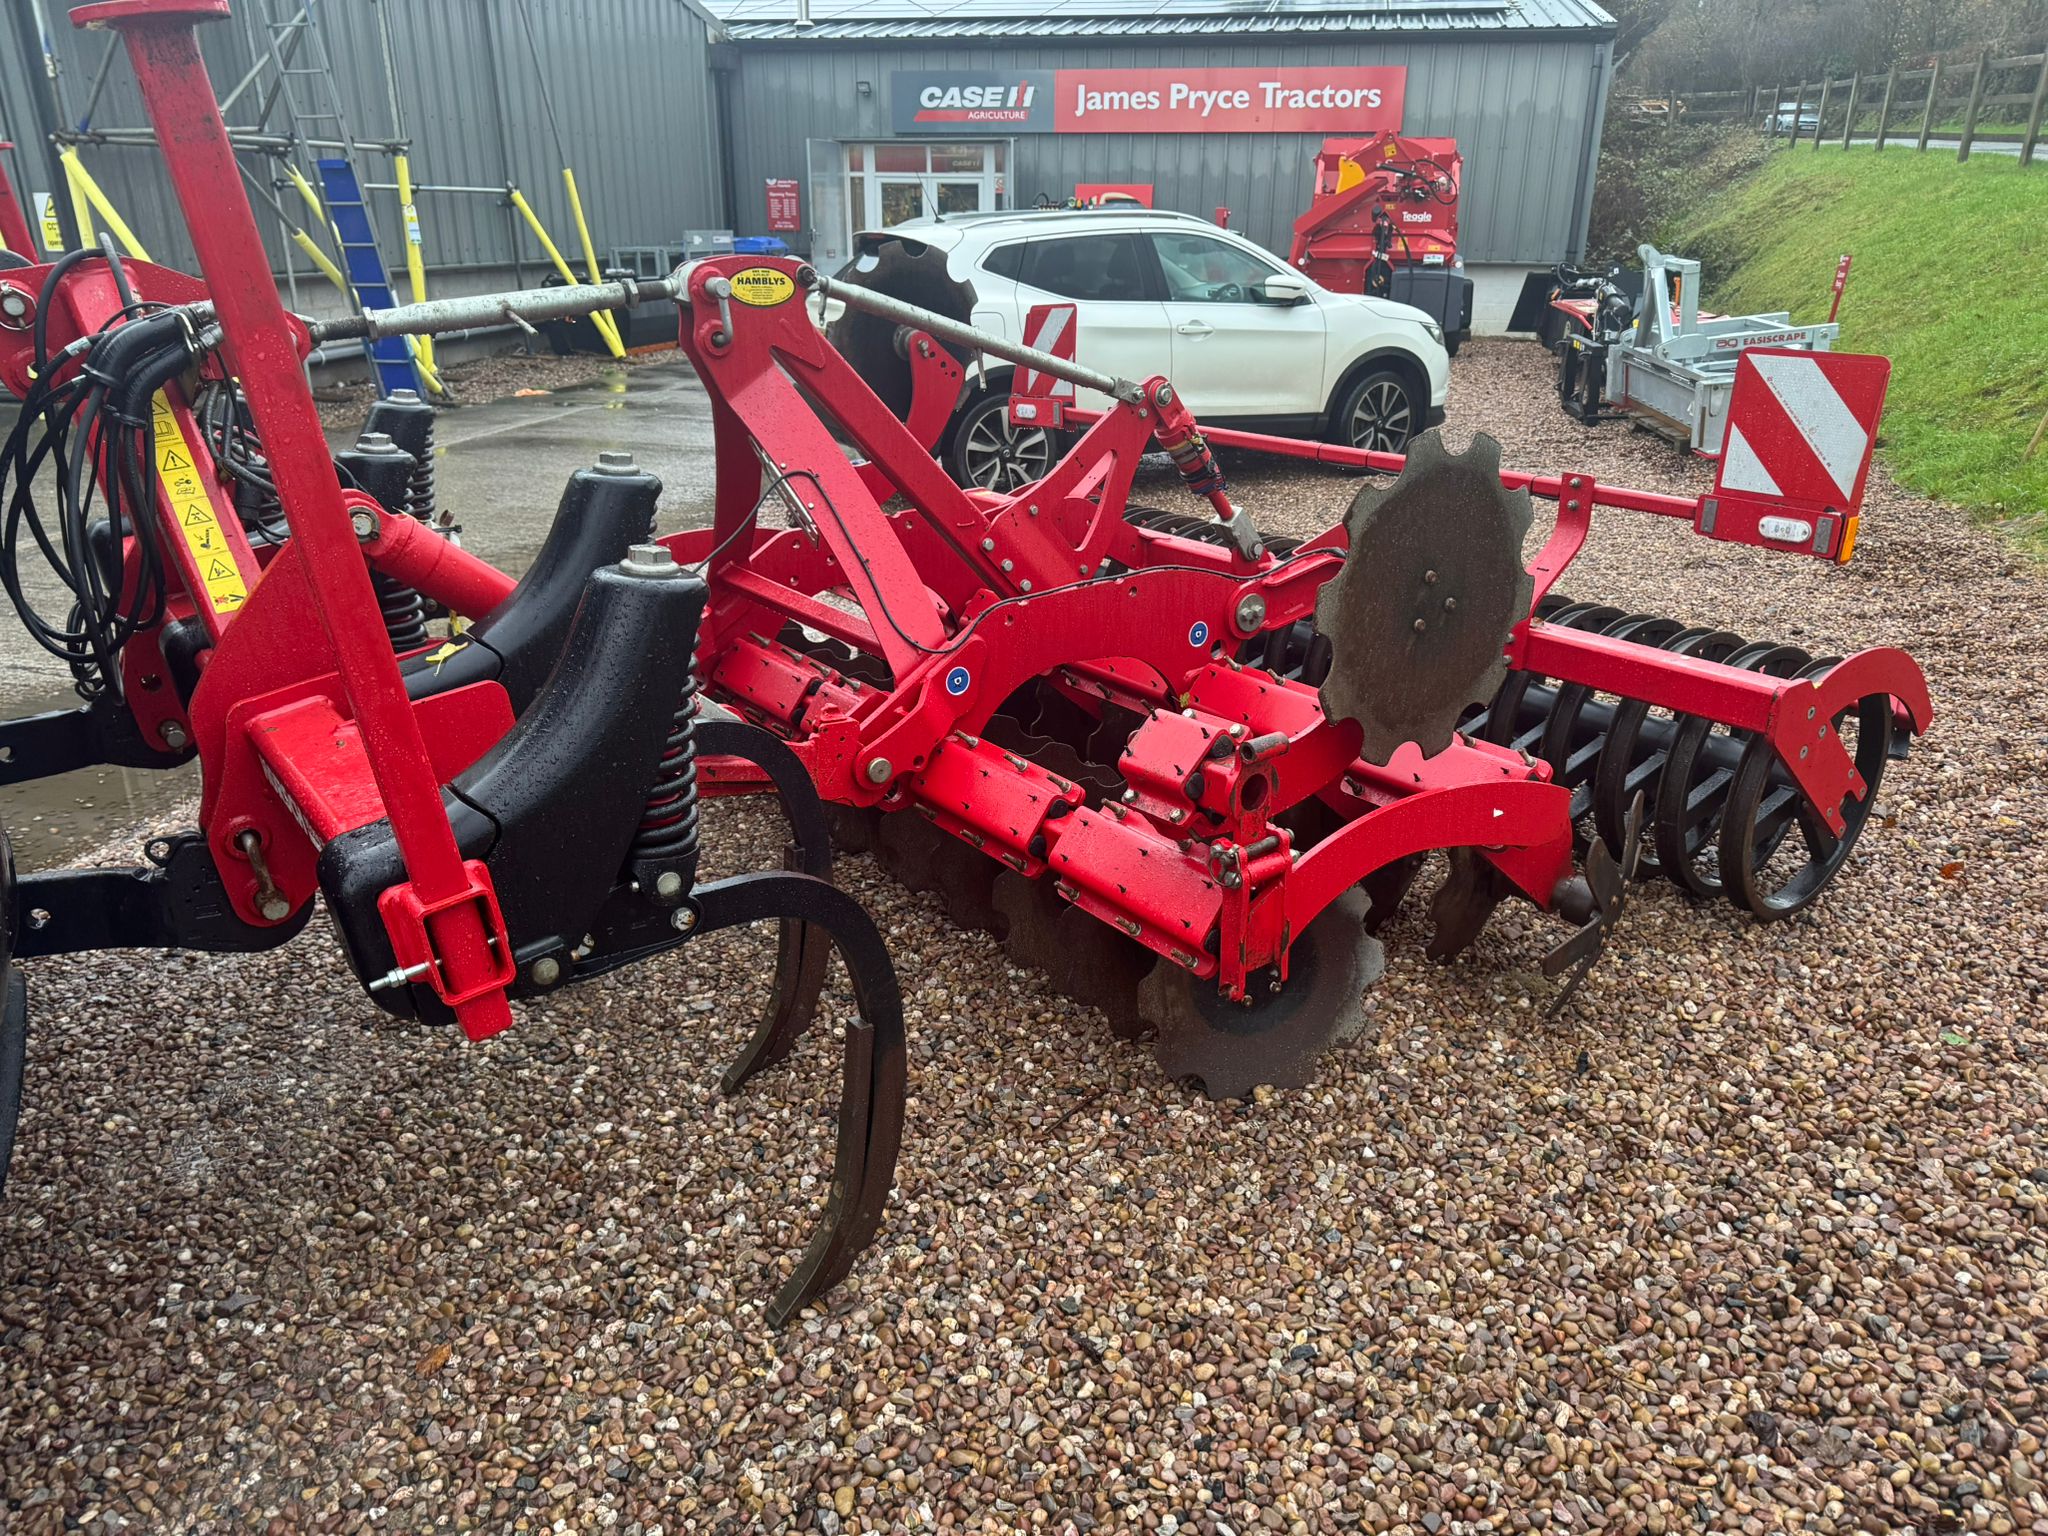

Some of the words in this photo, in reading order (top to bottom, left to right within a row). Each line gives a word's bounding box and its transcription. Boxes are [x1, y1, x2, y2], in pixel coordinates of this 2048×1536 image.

[919, 86, 1005, 108] CASE
[1074, 83, 1161, 117] James
[1169, 82, 1250, 117] Pryce
[1258, 81, 1382, 109] Tractors
[967, 111, 1026, 120] AGRICULTURE
[1402, 211, 1432, 223] Teagle
[737, 276, 786, 286] HAMBLYS
[1743, 331, 1807, 346] EASISCRAPE
